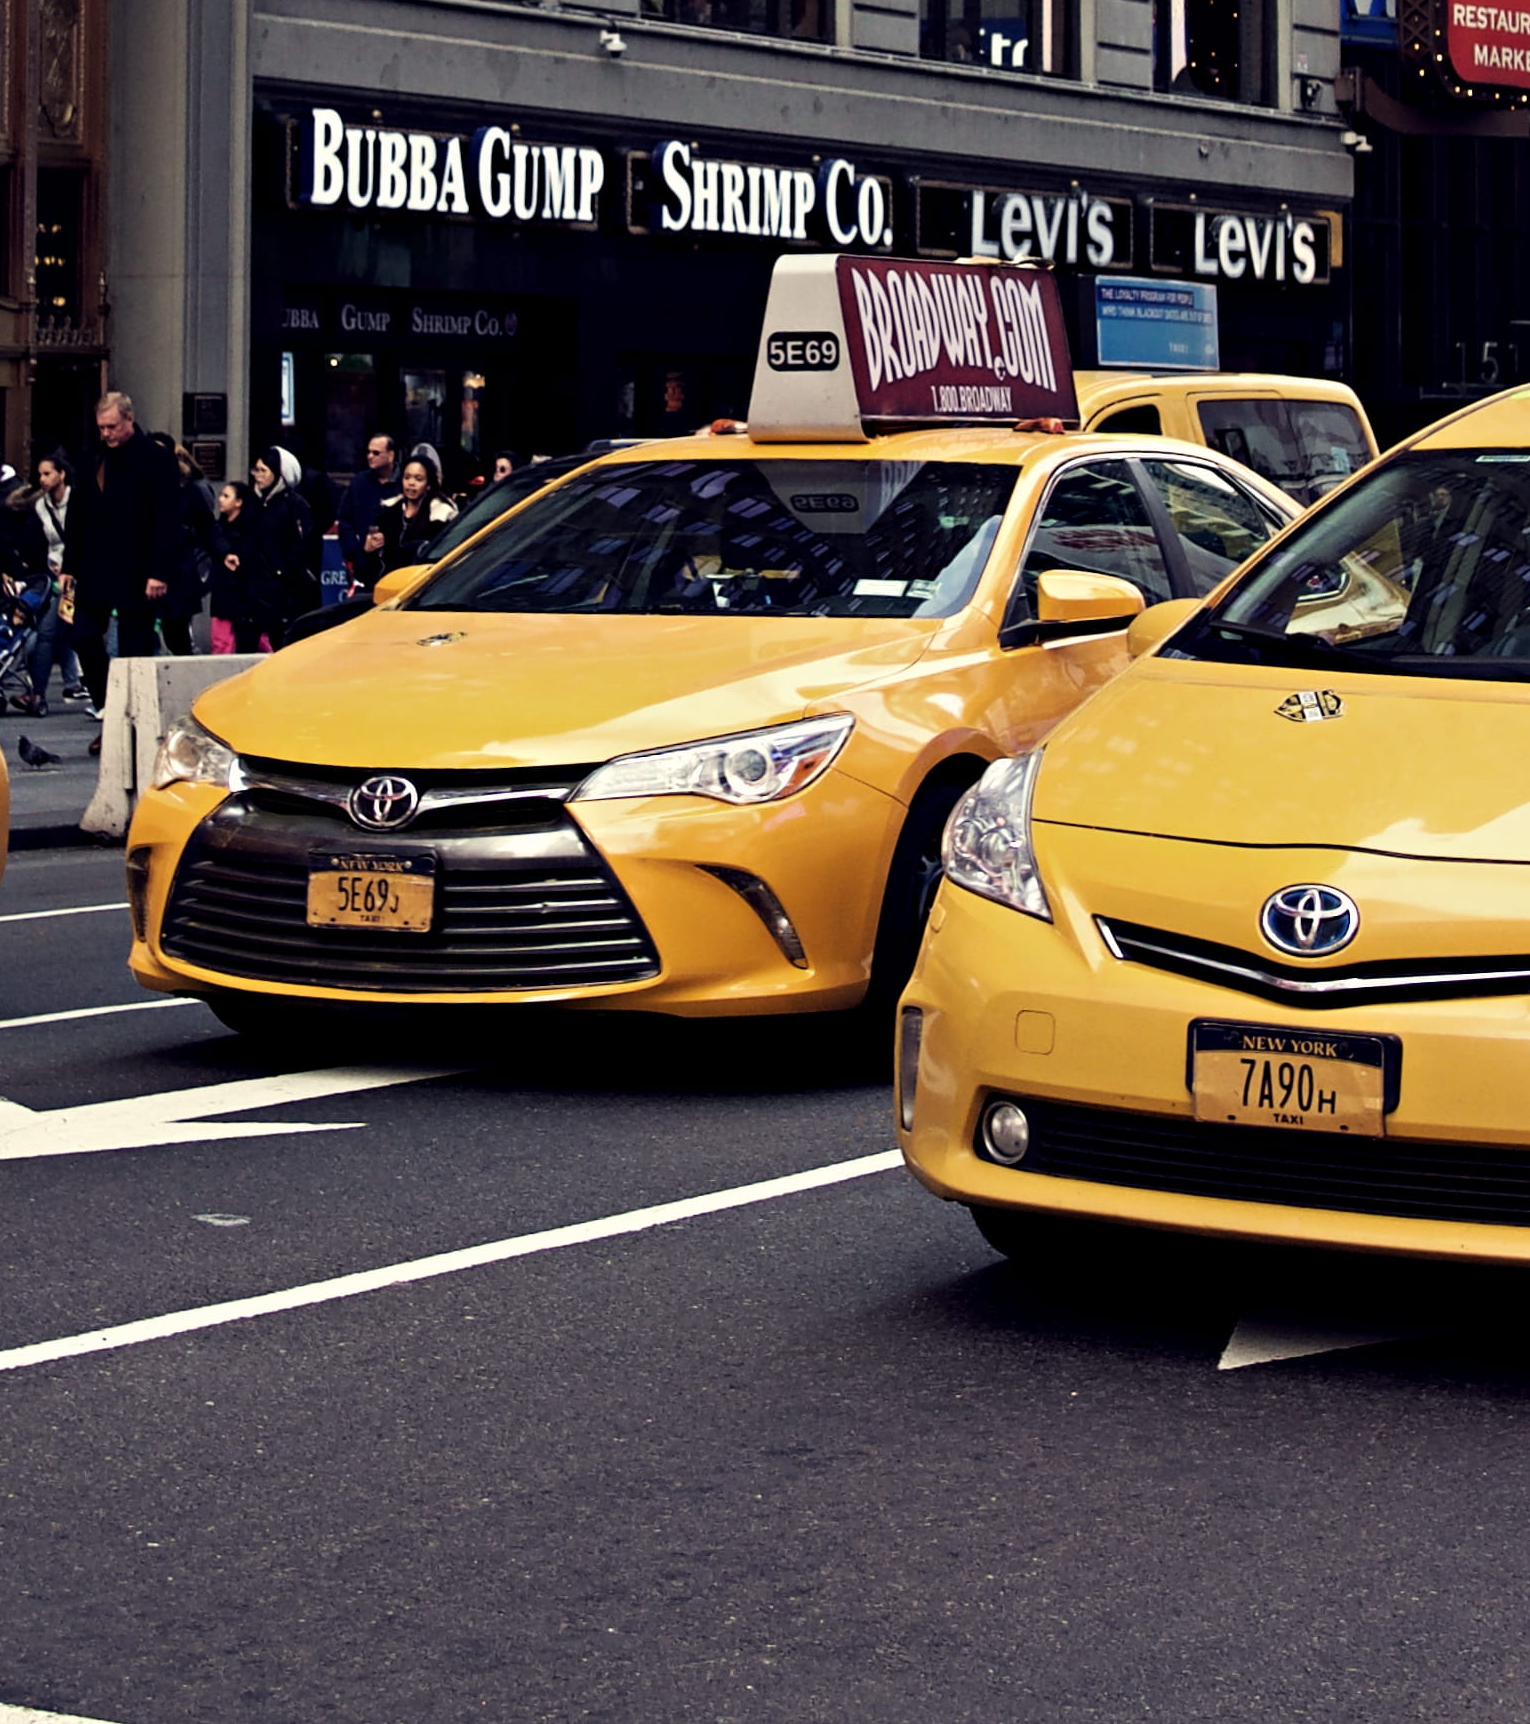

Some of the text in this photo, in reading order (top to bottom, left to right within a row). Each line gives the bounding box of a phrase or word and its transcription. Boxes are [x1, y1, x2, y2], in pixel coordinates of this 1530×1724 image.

[309, 107, 470, 215] BUBBA
[477, 126, 605, 223] GUMP
[660, 140, 816, 240] SHRIMP
[341, 303, 391, 332] GUMP
[411, 306, 471, 335] SHRIMP
[850, 266, 1058, 393] BROADWAY.COM
[770, 338, 838, 365] 5E69
[930, 385, 1012, 413] 1.800.BROADWAY
[340, 859, 371, 873] NEW
[337, 876, 400, 914] 5E69J
[1242, 1034, 1338, 1058] NEW YORK
[1240, 1058, 1337, 1115] 7A90H
[1273, 1113, 1304, 1126] TAXI
